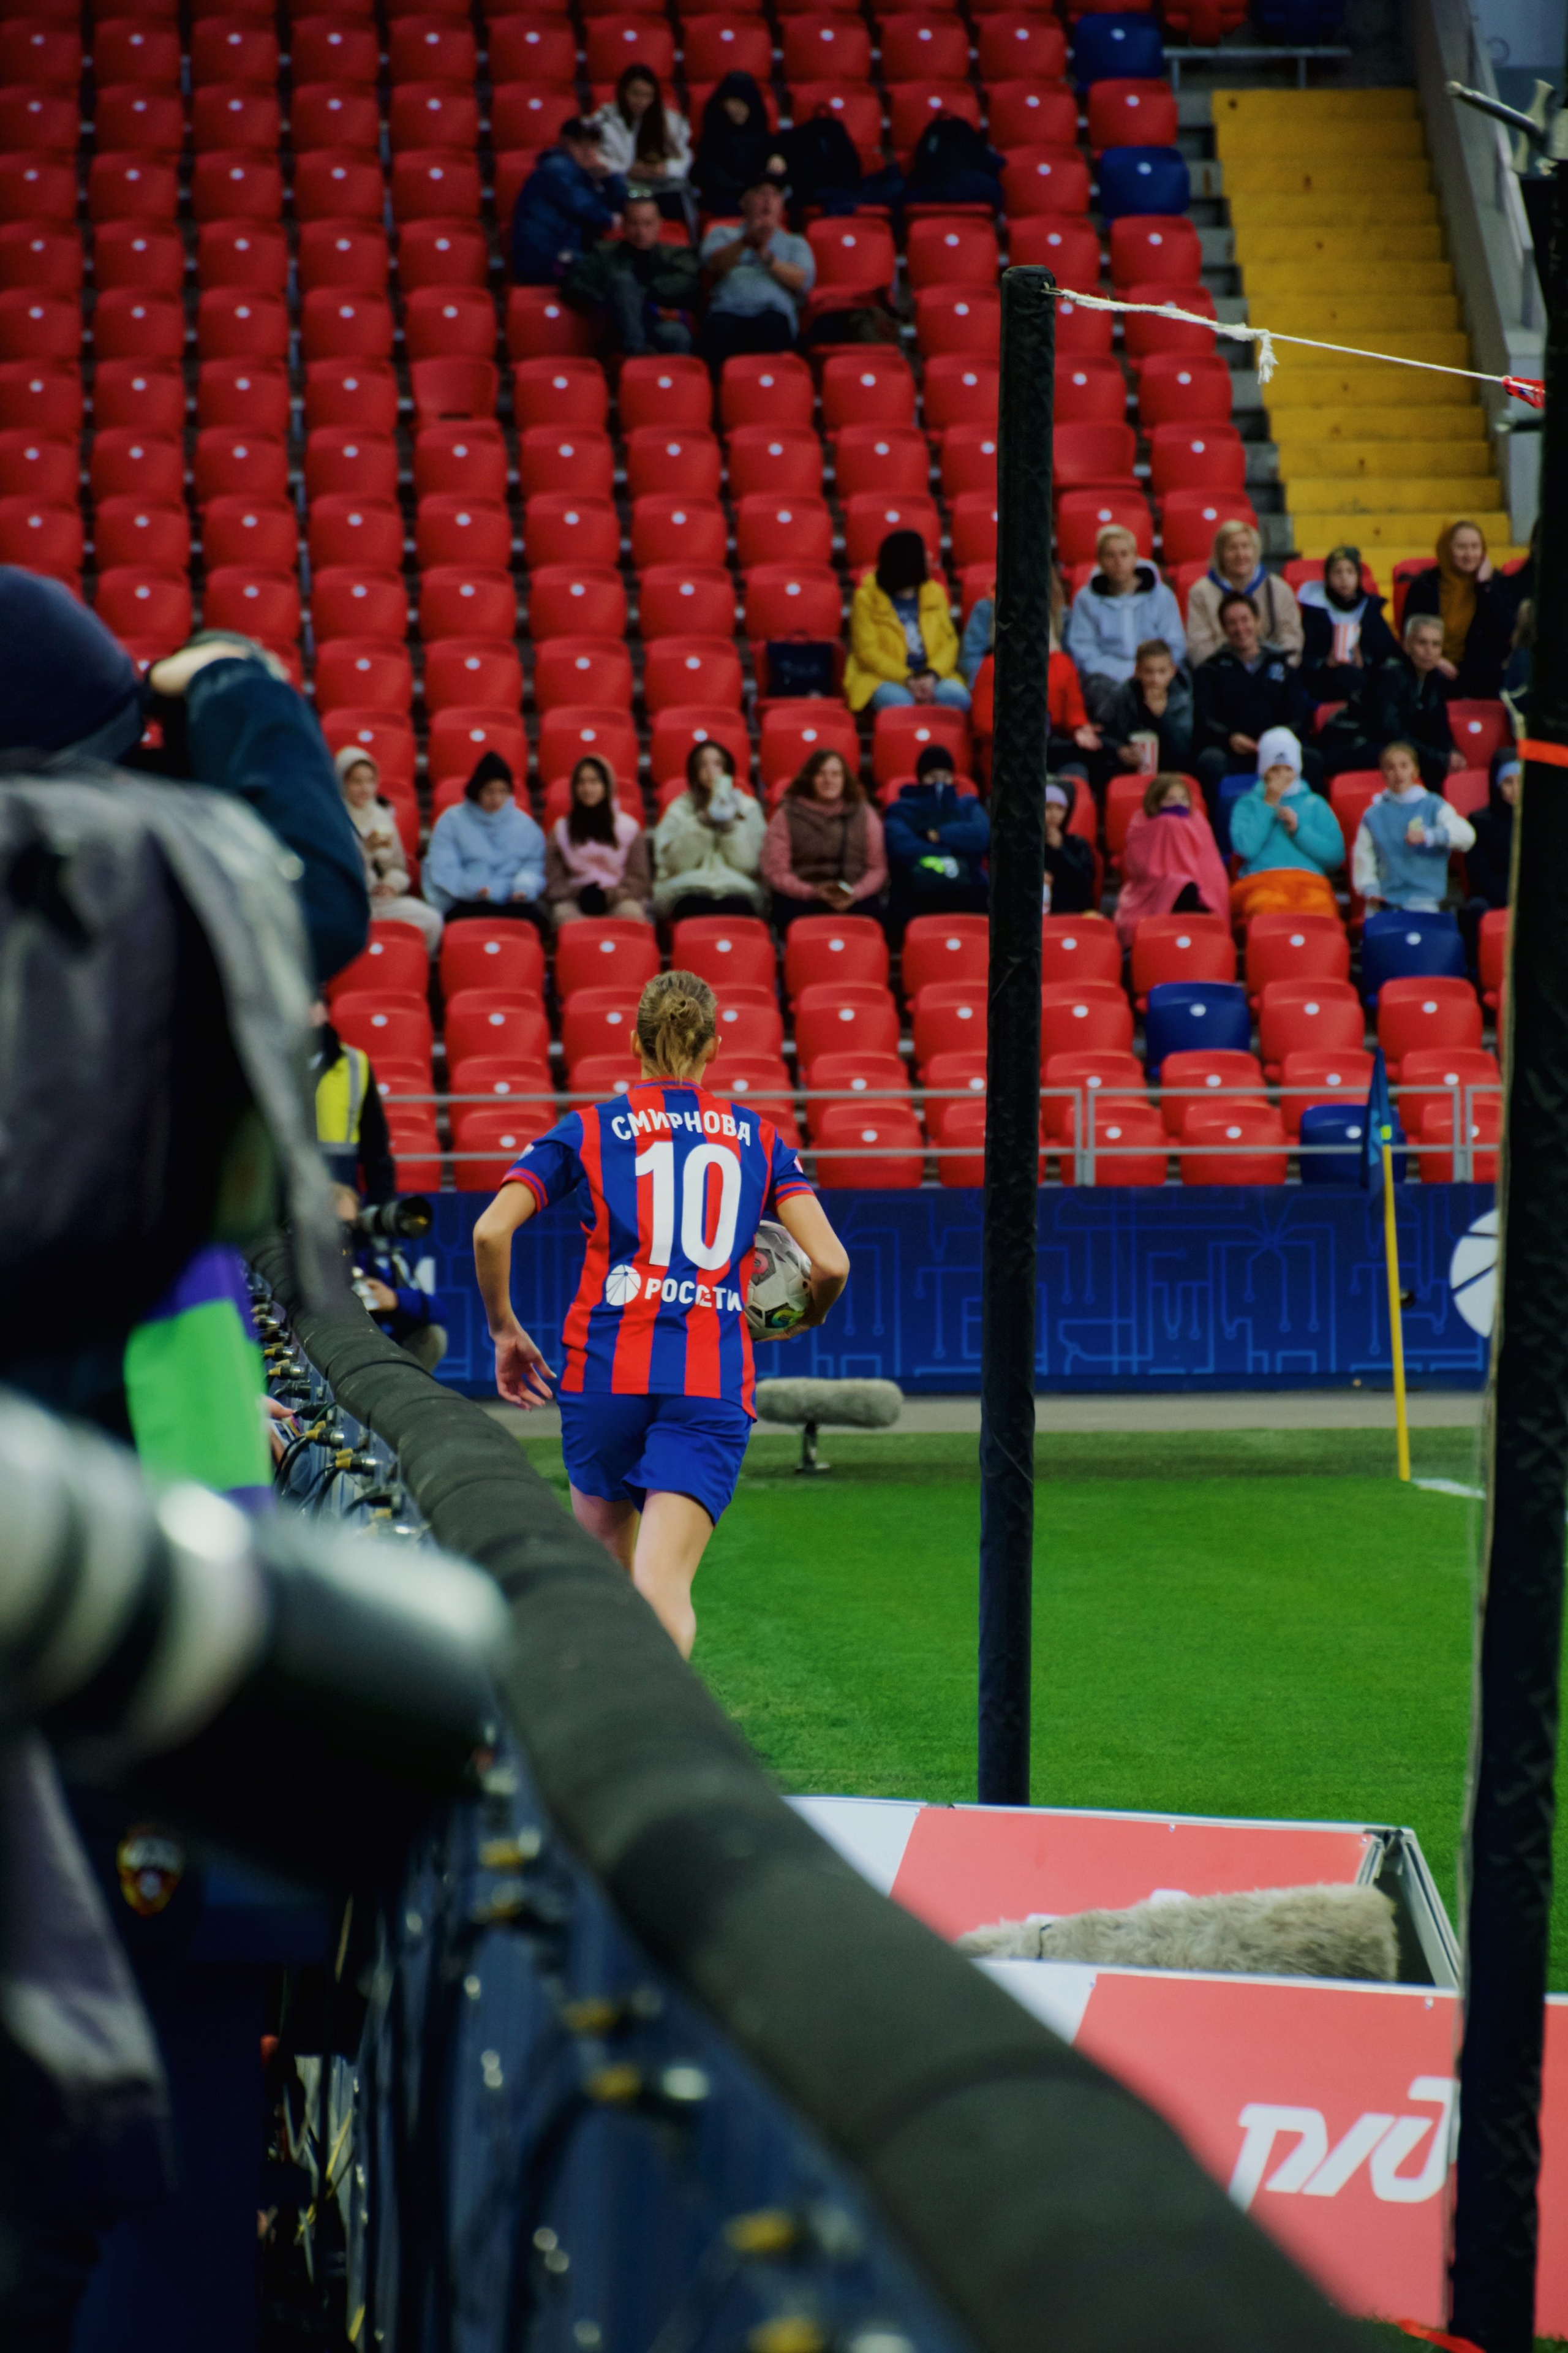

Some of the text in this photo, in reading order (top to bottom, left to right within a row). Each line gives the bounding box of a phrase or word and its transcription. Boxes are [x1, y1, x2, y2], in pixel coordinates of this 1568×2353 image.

[611, 1109, 751, 1146] СМИРНОВА
[635, 1141, 742, 1271] 10
[644, 1278, 743, 1311] РОСЕТИ
